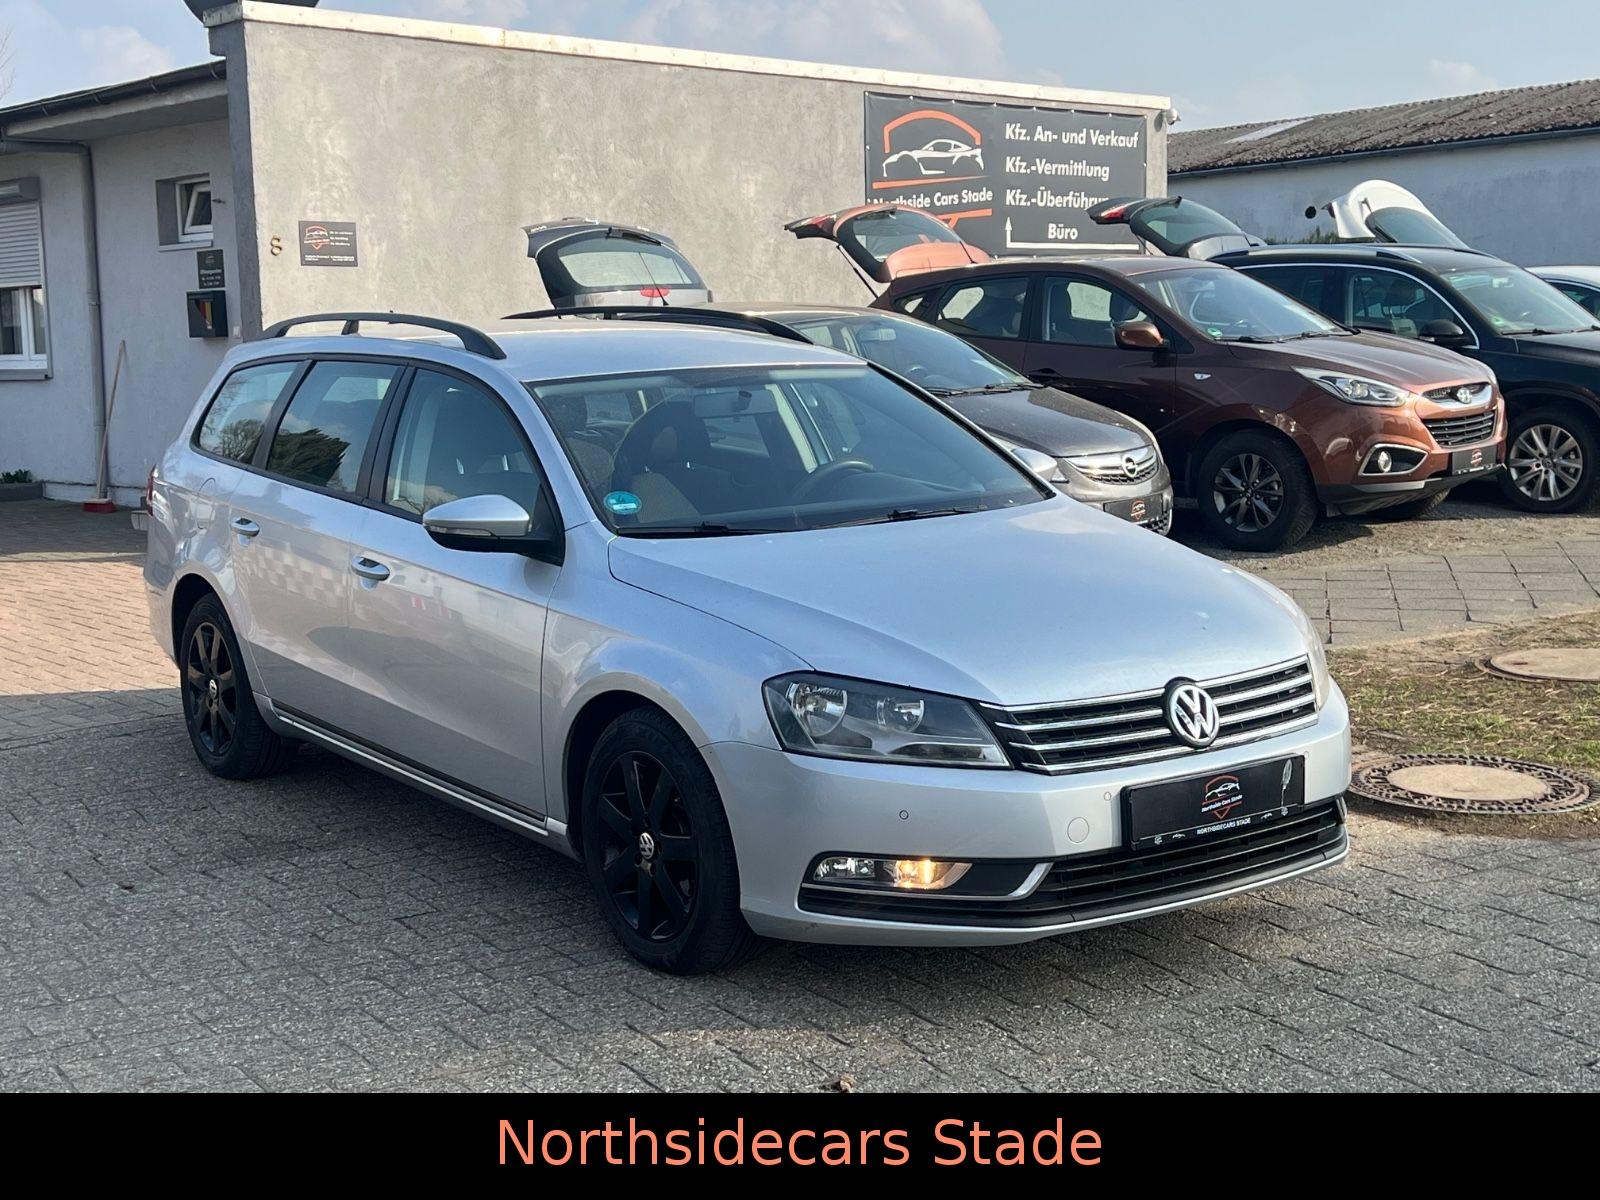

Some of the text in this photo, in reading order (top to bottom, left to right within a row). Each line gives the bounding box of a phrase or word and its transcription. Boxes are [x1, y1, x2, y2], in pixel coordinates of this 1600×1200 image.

[1005, 123, 1139, 148] Kfz. An- und Verkauf
[1005, 156, 1110, 181] Kfz.-Vermittlung
[873, 187, 993, 208] thside Cars Stade
[1048, 223, 1078, 240] Büro
